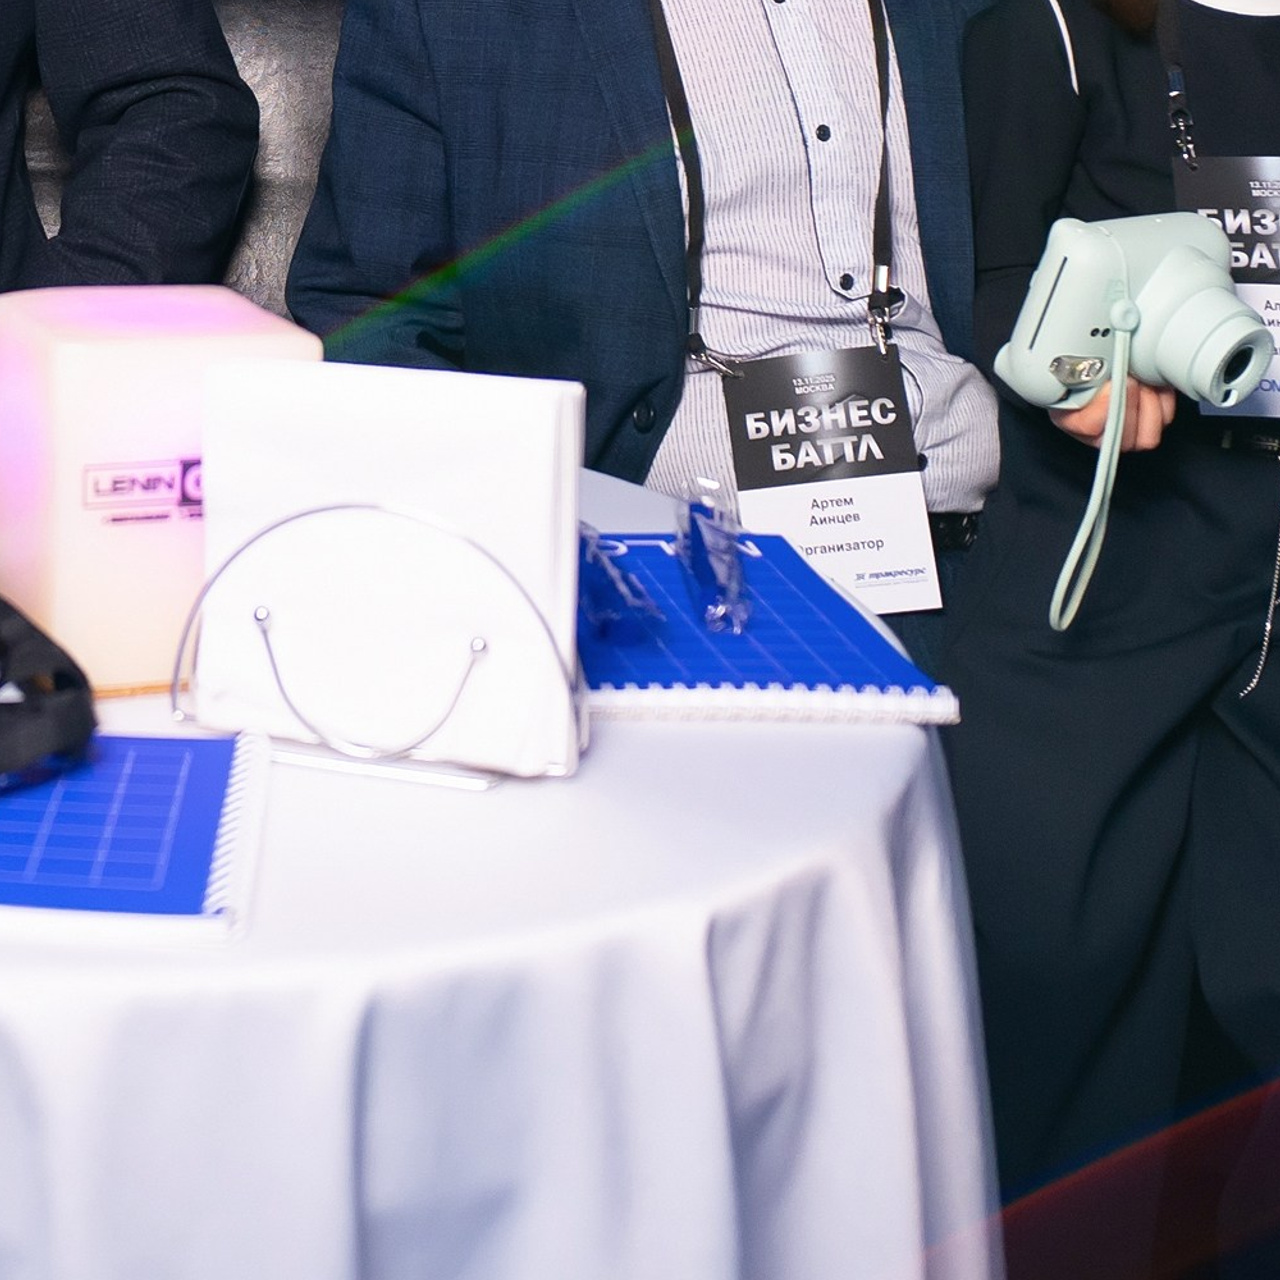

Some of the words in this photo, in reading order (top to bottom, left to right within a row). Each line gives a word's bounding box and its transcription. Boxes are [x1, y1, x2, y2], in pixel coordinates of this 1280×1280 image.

[794, 383, 835, 395] МОСКВА
[745, 397, 897, 440] БИЗНЕС
[771, 433, 884, 471] БАТТЛ
[811, 497, 854, 511] Артем
[809, 513, 861, 526] Аинцев
[798, 539, 885, 556] рганизатор
